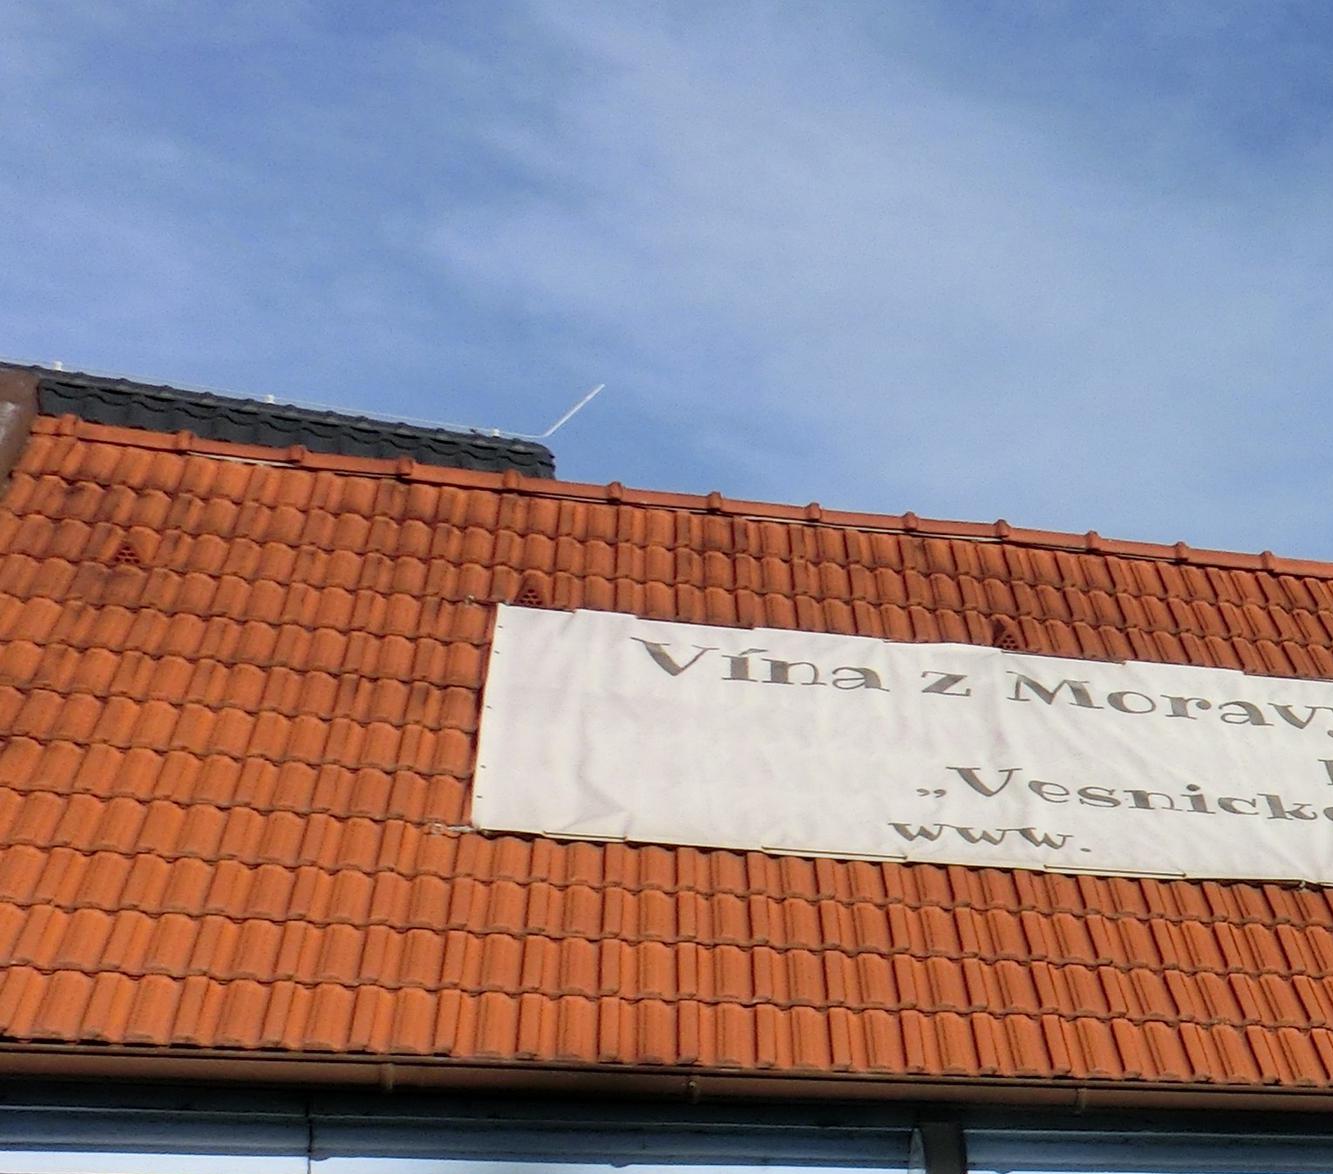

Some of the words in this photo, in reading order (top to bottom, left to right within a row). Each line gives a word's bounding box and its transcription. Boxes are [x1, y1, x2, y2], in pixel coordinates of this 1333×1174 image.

[630, 636, 890, 693] Vína
[920, 669, 972, 698] z
[887, 822, 1093, 854] www.
